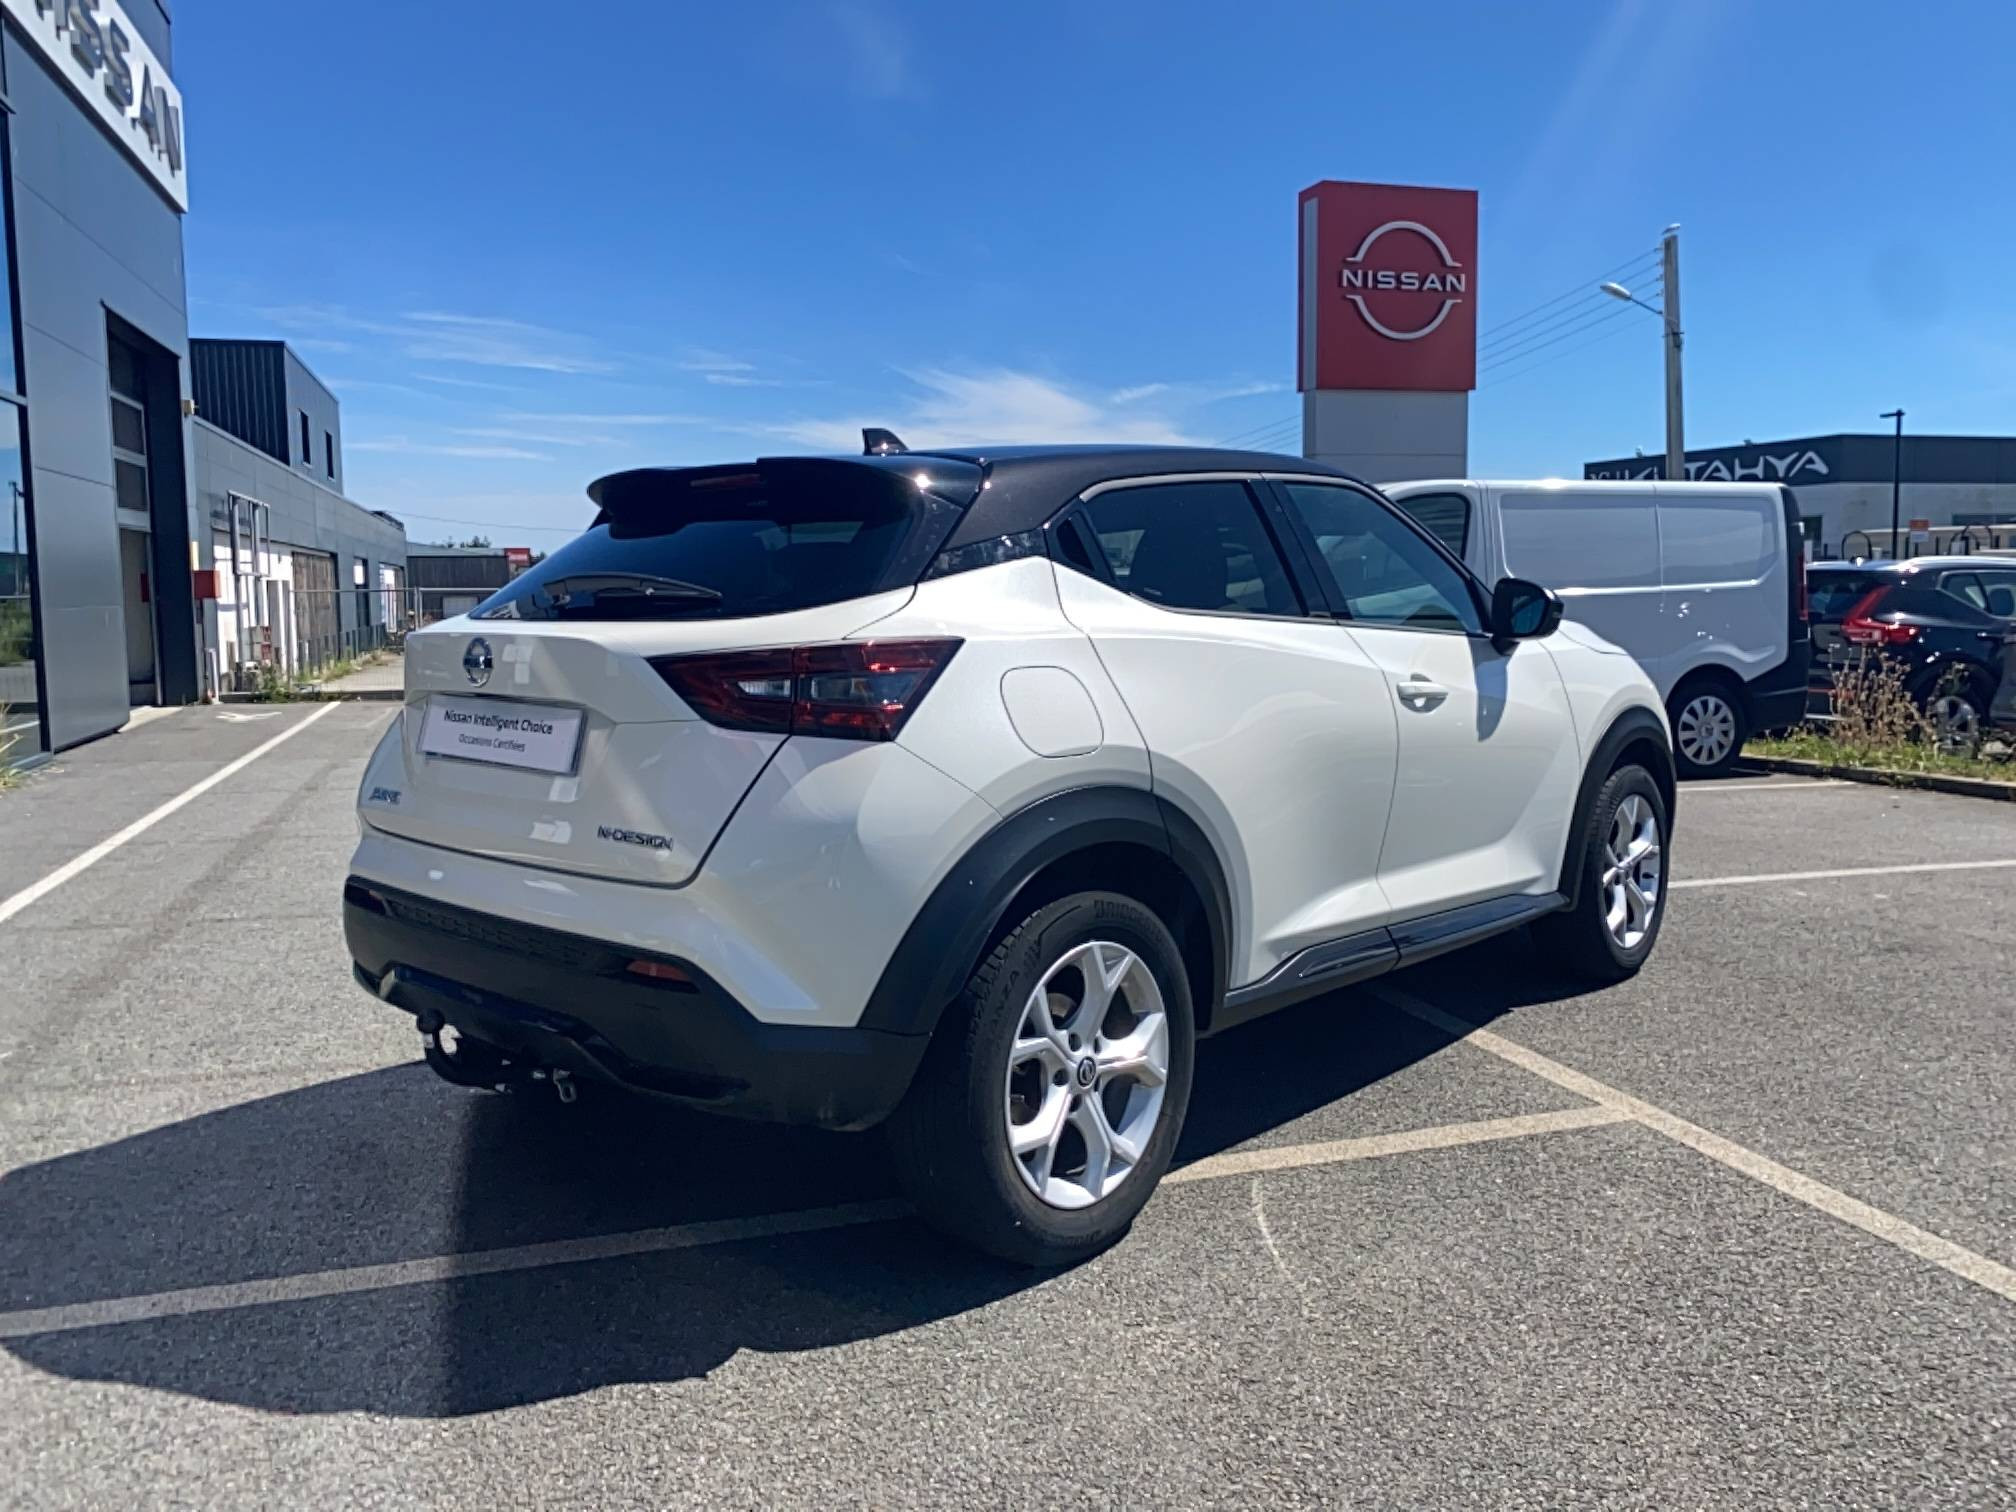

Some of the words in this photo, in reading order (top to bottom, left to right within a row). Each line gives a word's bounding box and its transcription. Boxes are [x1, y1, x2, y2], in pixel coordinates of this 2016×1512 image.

[1342, 269, 1465, 292] NISSAN
[444, 710, 473, 724] Nissan
[474, 714, 519, 732] Intelligent
[521, 719, 553, 735] Choice
